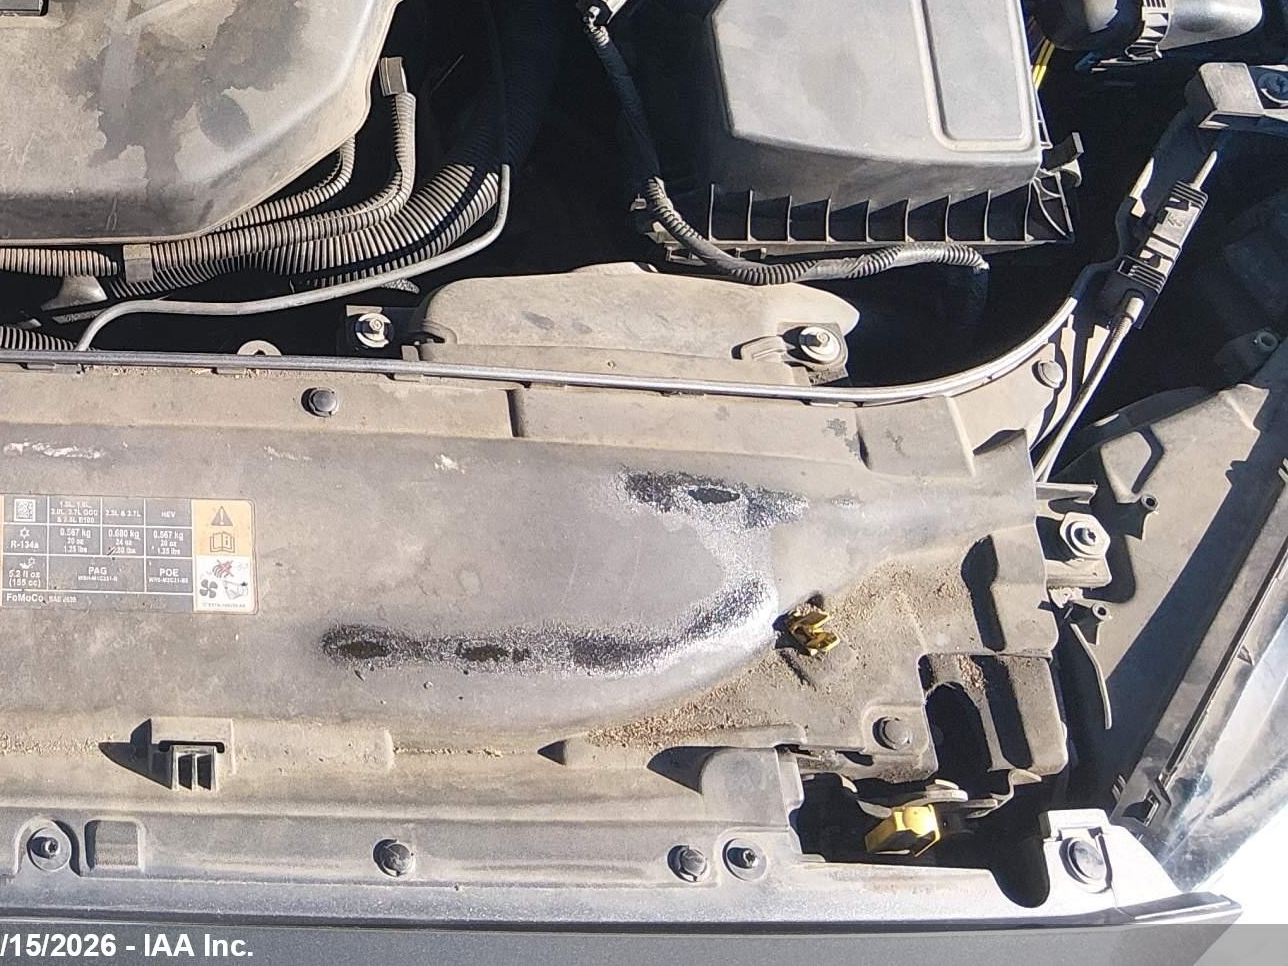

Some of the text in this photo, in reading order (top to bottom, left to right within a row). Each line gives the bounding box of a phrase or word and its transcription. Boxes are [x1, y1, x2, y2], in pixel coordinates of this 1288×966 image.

[81, 528, 91, 538] kg
[130, 529, 140, 539] kg
[174, 530, 184, 541] kg
[10, 540, 40, 549] R-134a
[115, 538, 124, 546] 24
[77, 545, 88, 553] lbs
[126, 546, 136, 554] lbs
[88, 566, 108, 575] PAG
[159, 568, 180, 577] POE
[28, 579, 41, 587] cc)
[6, 593, 44, 603] FoMoCo
